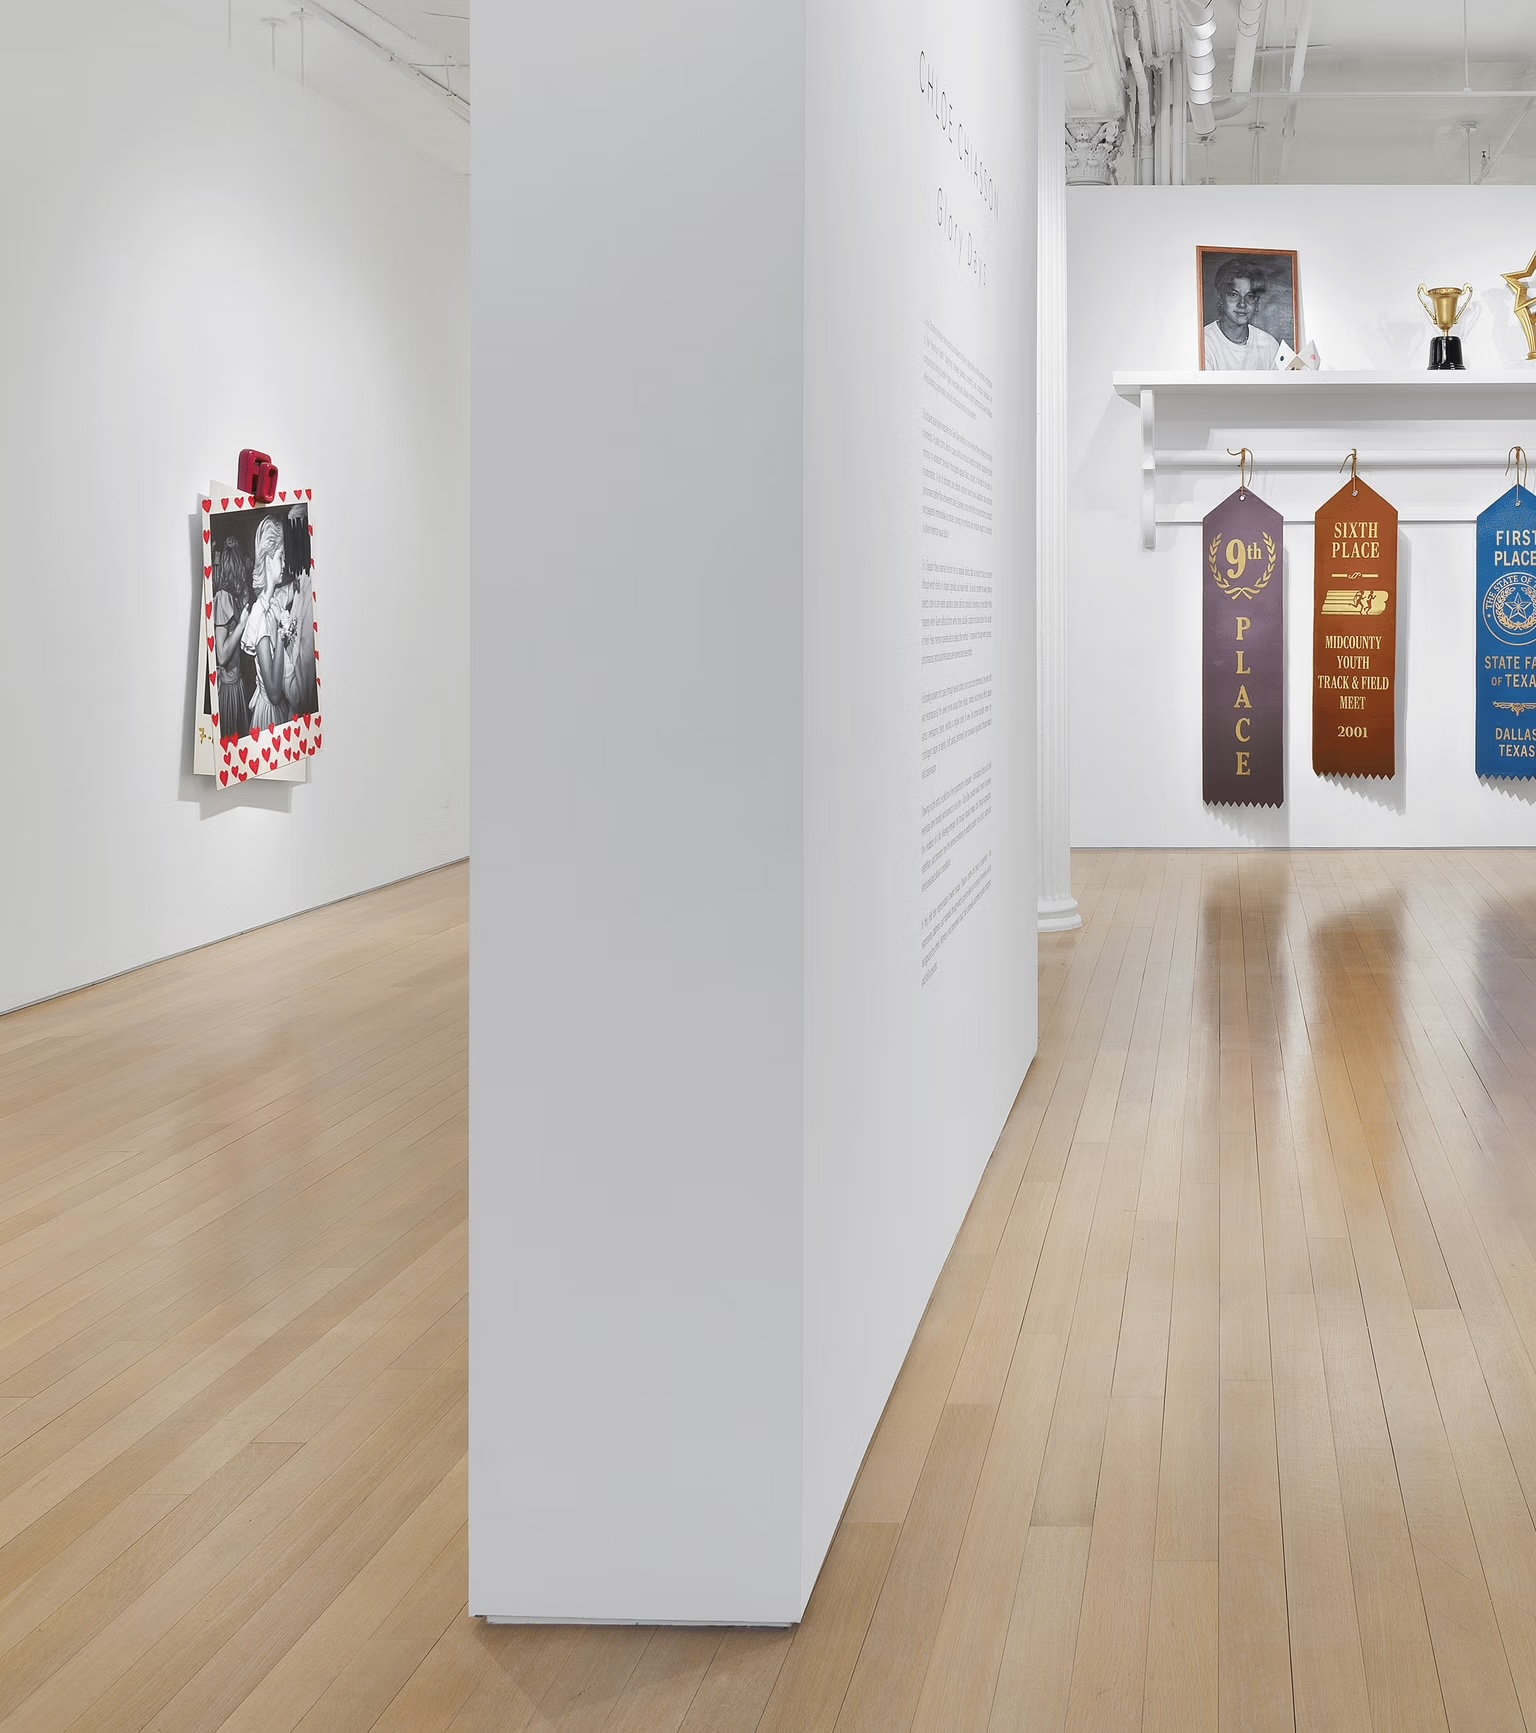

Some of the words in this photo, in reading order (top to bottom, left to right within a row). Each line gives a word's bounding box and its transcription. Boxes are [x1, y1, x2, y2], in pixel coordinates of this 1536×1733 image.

[919, 50, 953, 143] CHLOE
[937, 187, 963, 265] Glory
[967, 232, 986, 287] Days
[1334, 522, 1378, 538] SIXTH
[1332, 542, 1380, 558] PLACE
[1225, 538, 1262, 579] 9th
[1485, 591, 1496, 610] THE
[1494, 575, 1519, 592] STATE
[1520, 575, 1532, 584] OF
[1325, 636, 1382, 650] MIDCOUNTY
[1337, 656, 1370, 669] YOUTH
[1484, 656, 1520, 670] STATE
[1318, 675, 1349, 689] TRACK
[1351, 676, 1359, 690] &
[1361, 676, 1389, 690] FIELD
[1491, 677, 1502, 686] OF
[1233, 616, 1252, 776] PLACE
[1340, 696, 1366, 709] MEET
[1337, 726, 1368, 738] 2001
[1499, 744, 1535, 758] TEXAS
